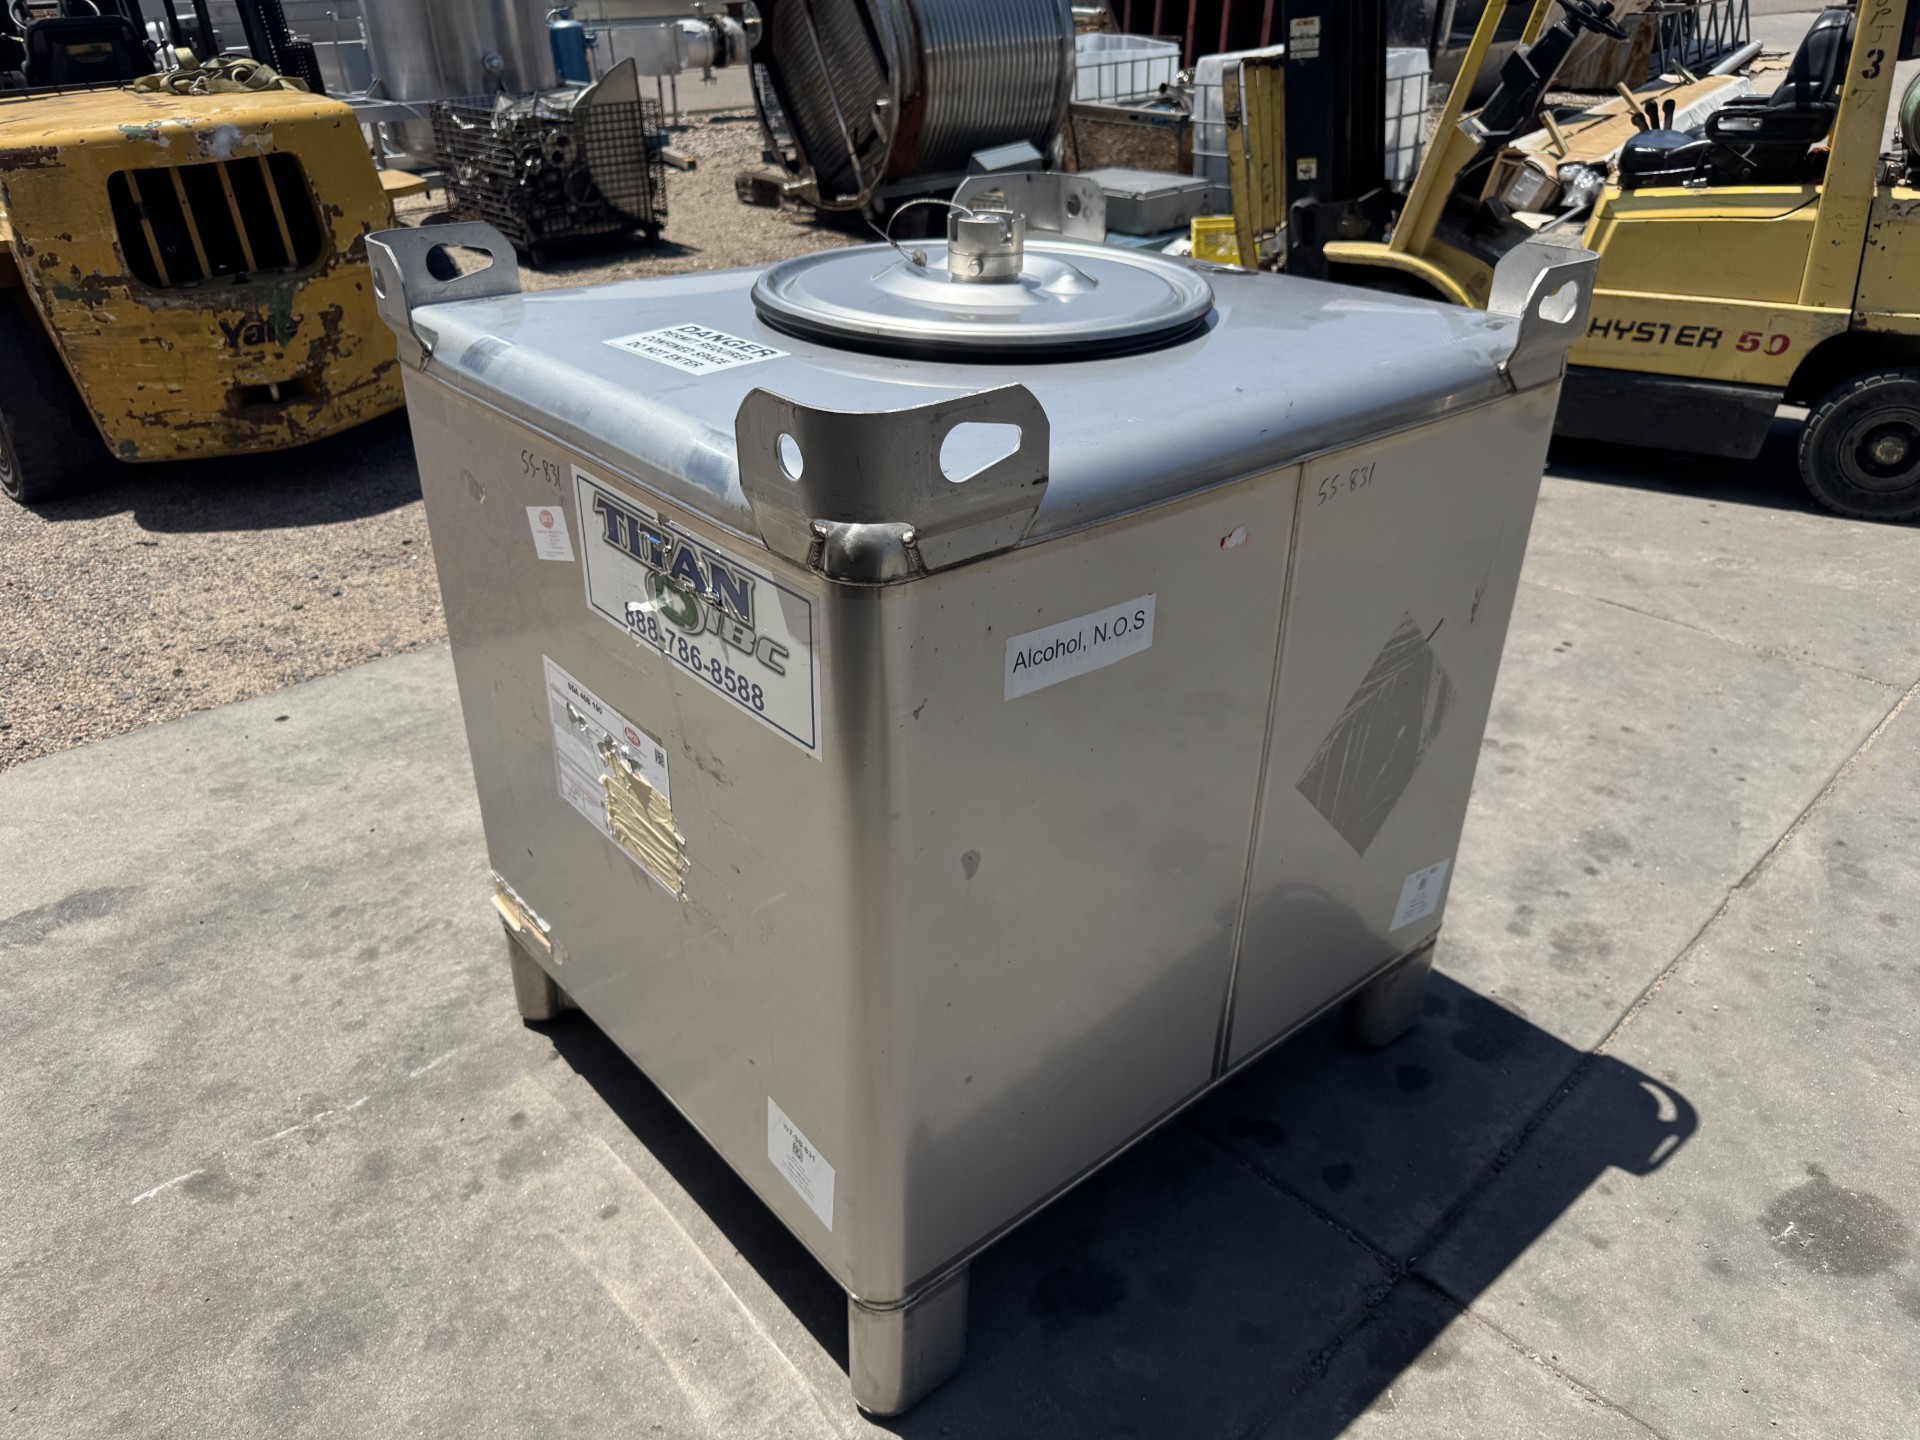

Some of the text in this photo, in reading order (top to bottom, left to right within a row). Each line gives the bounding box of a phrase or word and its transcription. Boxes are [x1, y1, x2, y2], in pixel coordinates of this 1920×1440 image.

[1861, 48, 1886, 80] 3
[218, 315, 299, 349] Yale
[657, 330, 755, 360] PERMIT REQUIRED
[676, 325, 779, 356] DANGER
[1586, 317, 1791, 357] HYSTER 50
[640, 335, 732, 364] CONFINED SPACE
[641, 346, 669, 355] NOT
[661, 353, 705, 367] ENTER
[594, 491, 757, 628] TITAN
[624, 601, 765, 712] 888-786-8588
[706, 611, 791, 678] IBC
[1012, 609, 1146, 673] Alcohol, N.O.S
